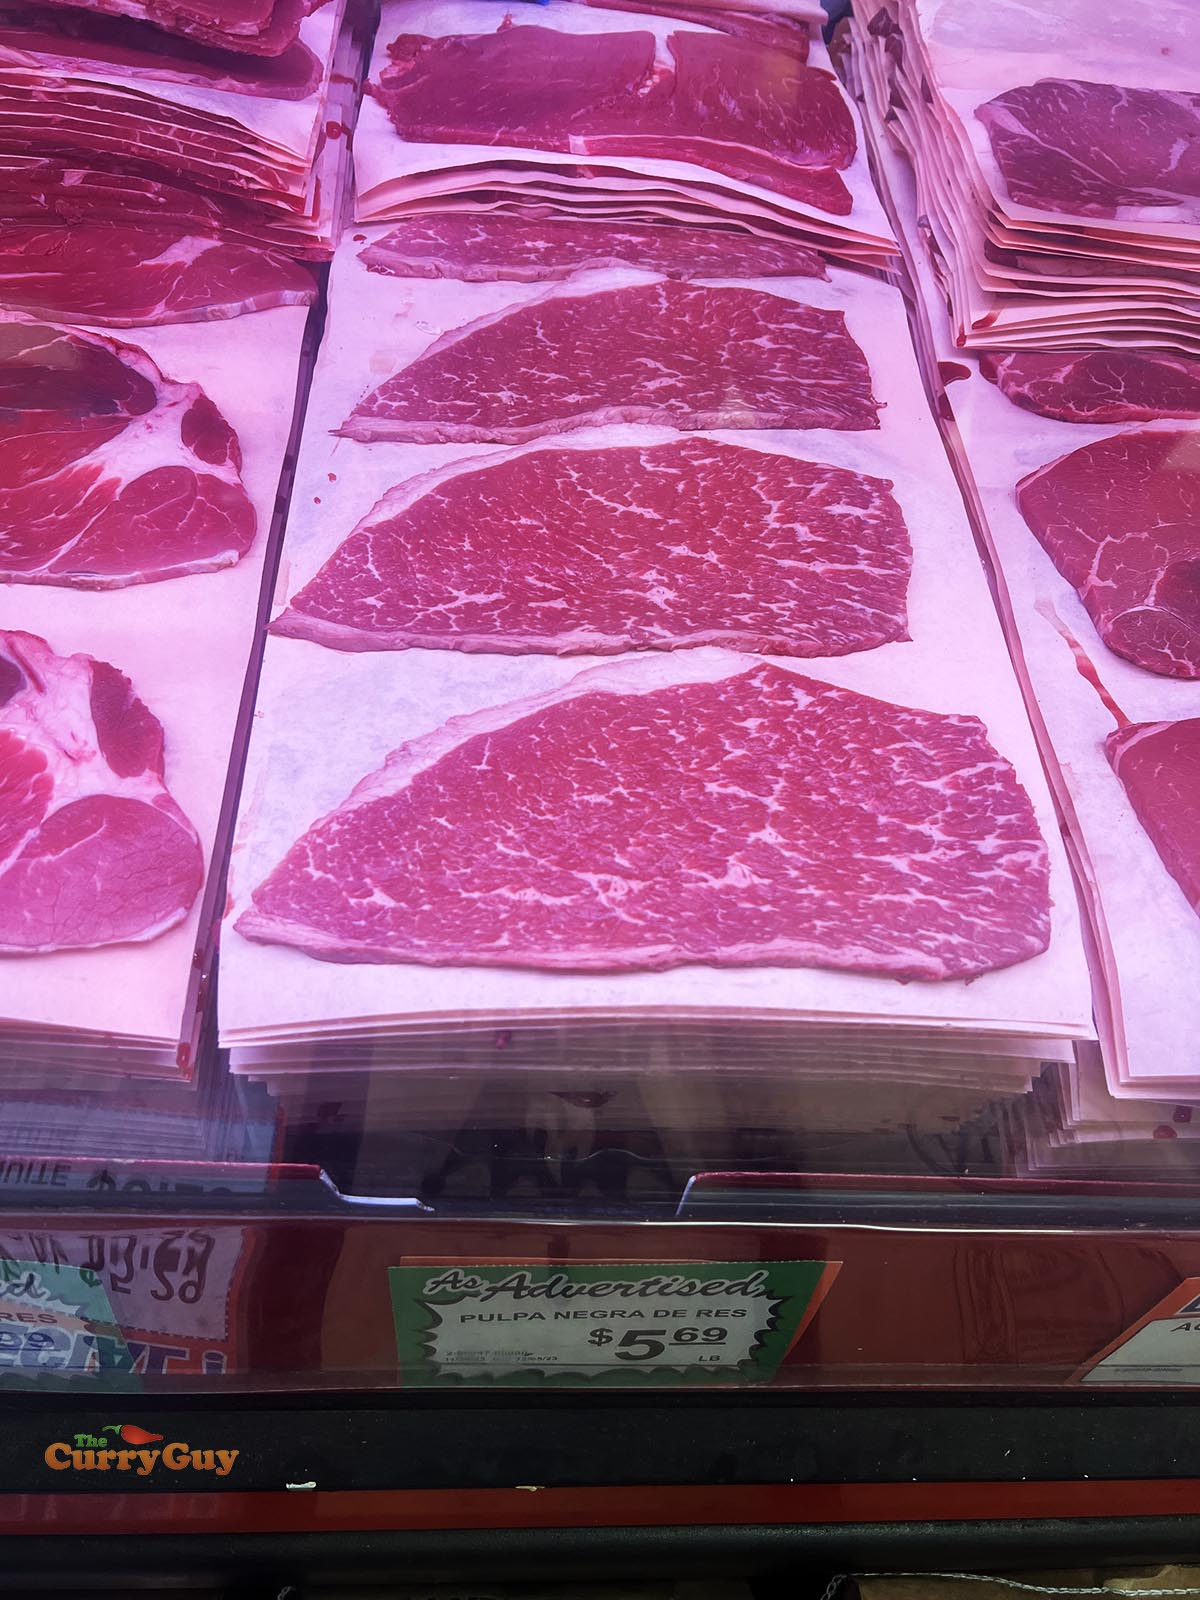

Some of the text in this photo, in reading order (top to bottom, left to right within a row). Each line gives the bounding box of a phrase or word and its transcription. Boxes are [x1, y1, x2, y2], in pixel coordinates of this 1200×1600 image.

[426, 1270, 768, 1302] As Advertised
[0, 1312, 58, 1323] RES
[460, 1309, 747, 1323] PULPA NEGRA DE RES
